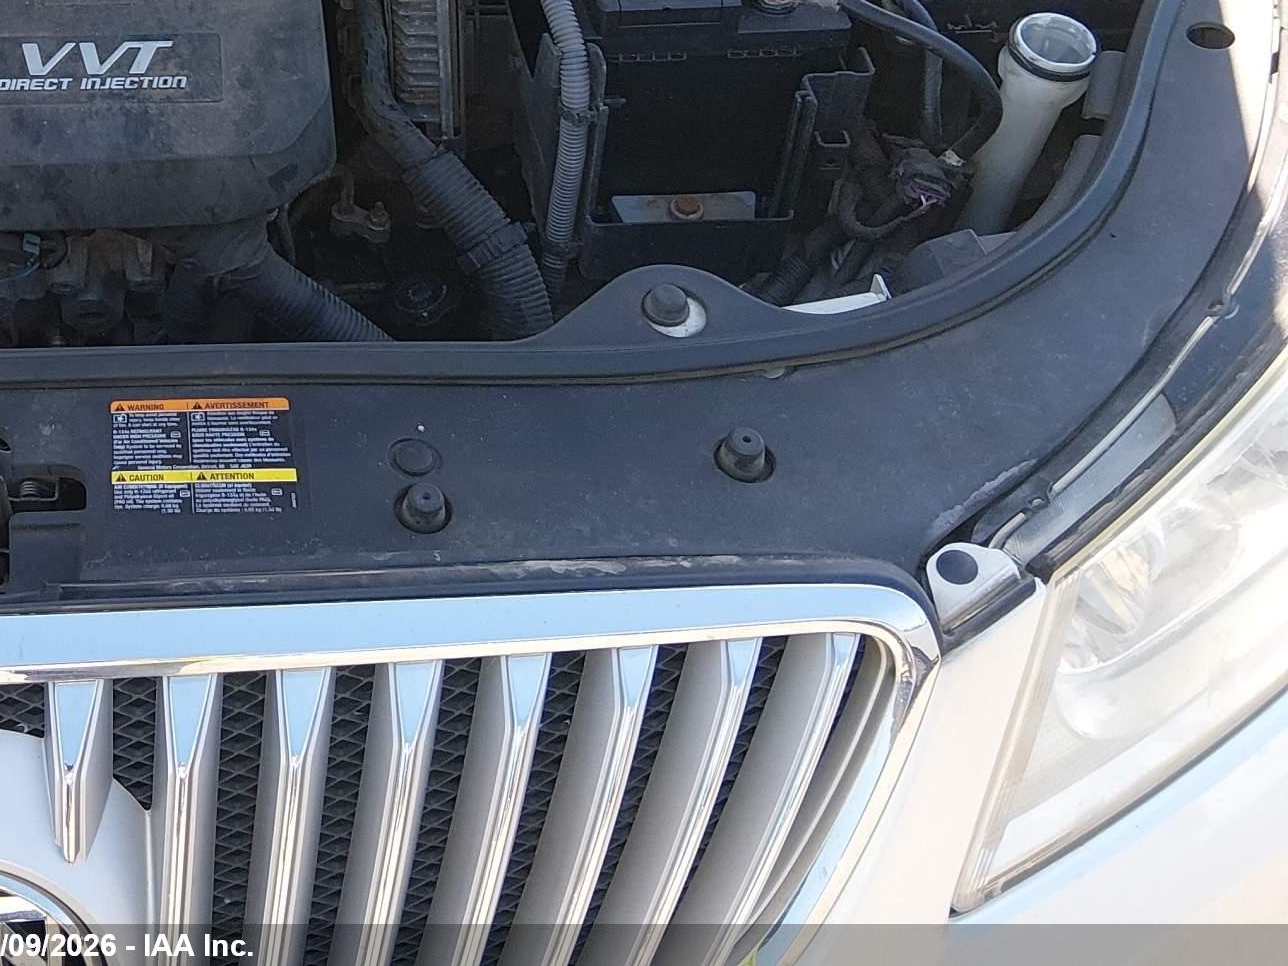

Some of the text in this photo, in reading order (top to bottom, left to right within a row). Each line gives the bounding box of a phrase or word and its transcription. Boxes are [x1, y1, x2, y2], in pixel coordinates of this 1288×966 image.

[21, 40, 174, 76] VVT
[80, 75, 187, 91] INJECTION
[127, 403, 165, 411] WARNING
[204, 401, 270, 410] AVERTISSEMENT
[129, 473, 165, 482] CAUTION
[209, 472, 255, 481] ATTENTION
